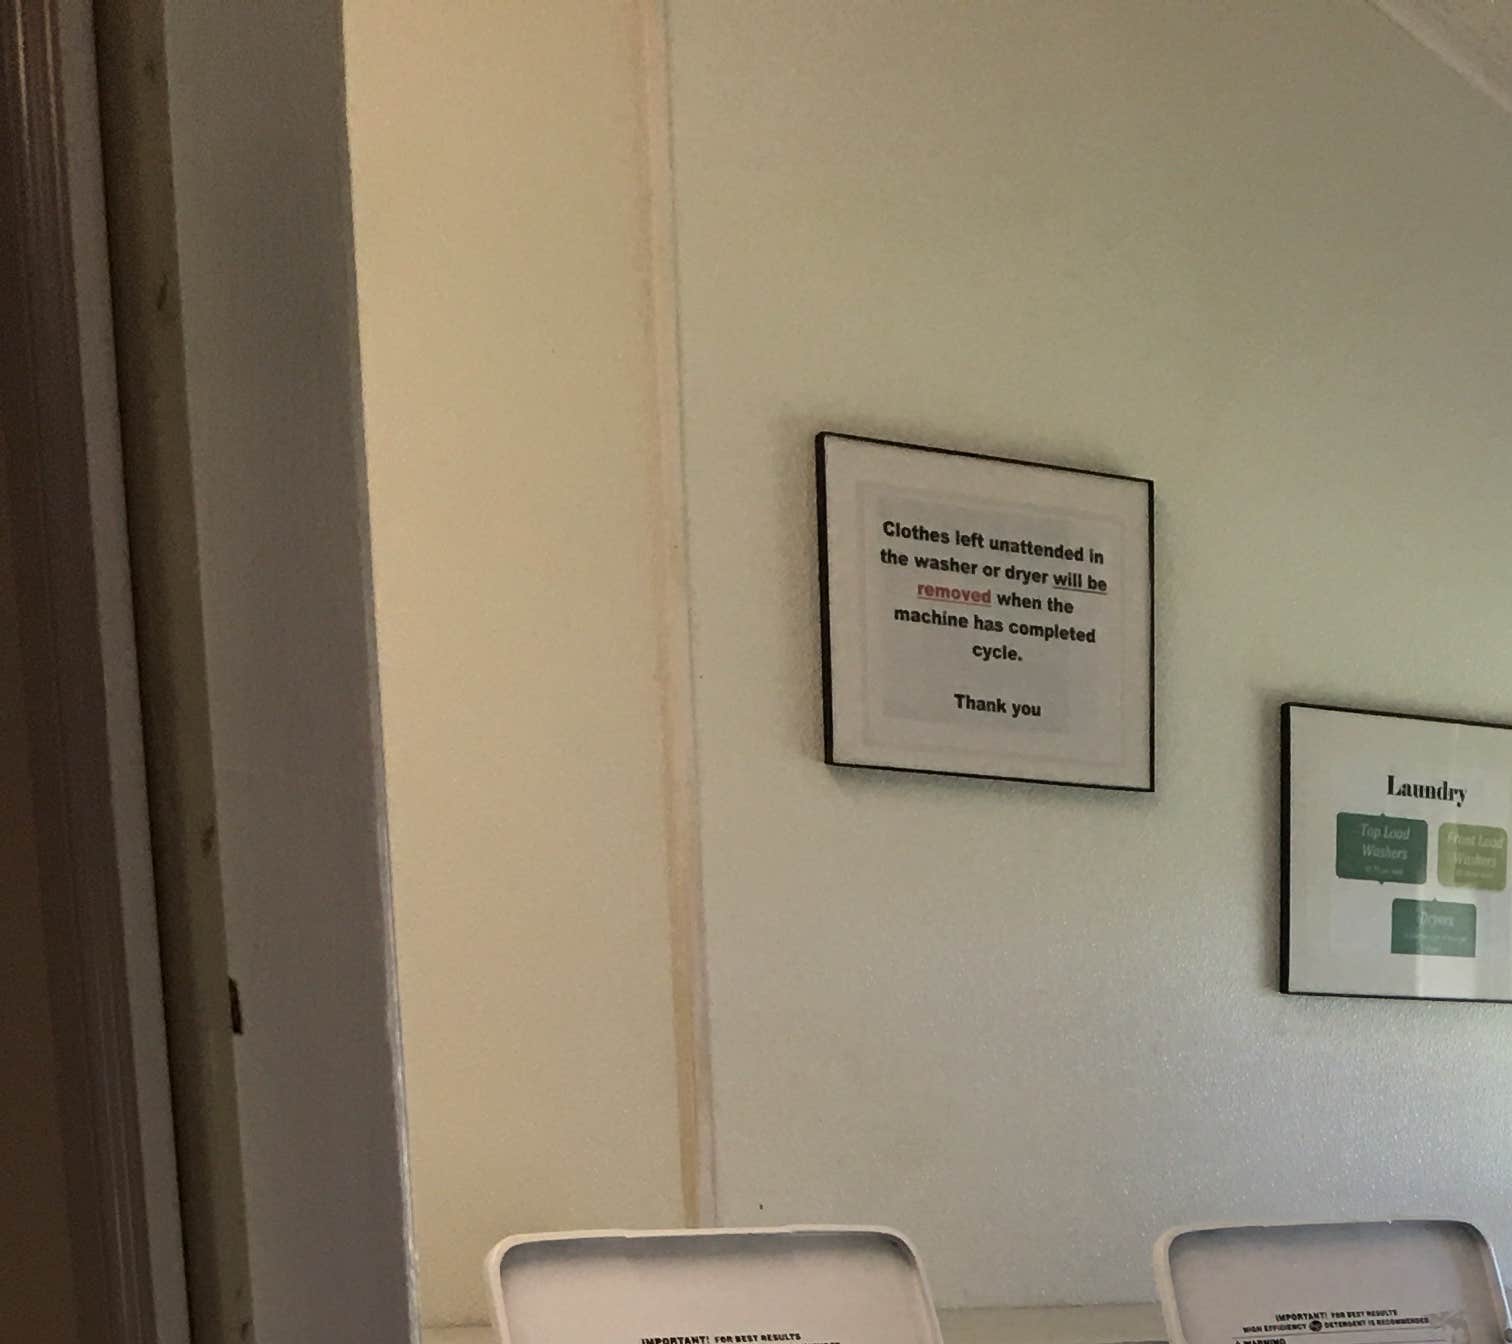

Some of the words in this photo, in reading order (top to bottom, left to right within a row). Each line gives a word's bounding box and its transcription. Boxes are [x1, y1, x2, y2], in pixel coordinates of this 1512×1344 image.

[883, 521, 950, 544] Clothes
[955, 530, 984, 548] left
[989, 537, 1084, 562] unattended
[1089, 549, 1104, 564] in
[881, 549, 909, 566] the
[914, 555, 978, 575] washer
[982, 565, 1000, 578] or
[1005, 566, 1048, 585] dryer
[1053, 572, 1083, 588] will
[1087, 575, 1107, 592] be
[917, 583, 992, 604] removed
[997, 592, 1042, 610] when
[1047, 597, 1074, 614] the
[894, 607, 968, 628] machine
[973, 615, 1004, 632] has
[1008, 621, 1096, 643] completed
[972, 644, 1023, 662] cycle.
[954, 693, 1007, 713] Thank
[1012, 702, 1041, 717] you
[1387, 775, 1468, 807] Laundry
[1360, 823, 1381, 838] Top
[1383, 824, 1410, 840] Load
[1362, 844, 1408, 860] Washers
[1275, 1312, 1328, 1322] IMPORTANT!
[715, 1336, 733, 1344] FOR
[736, 1334, 758, 1342] BEST
[761, 1333, 801, 1342] RESULTS
